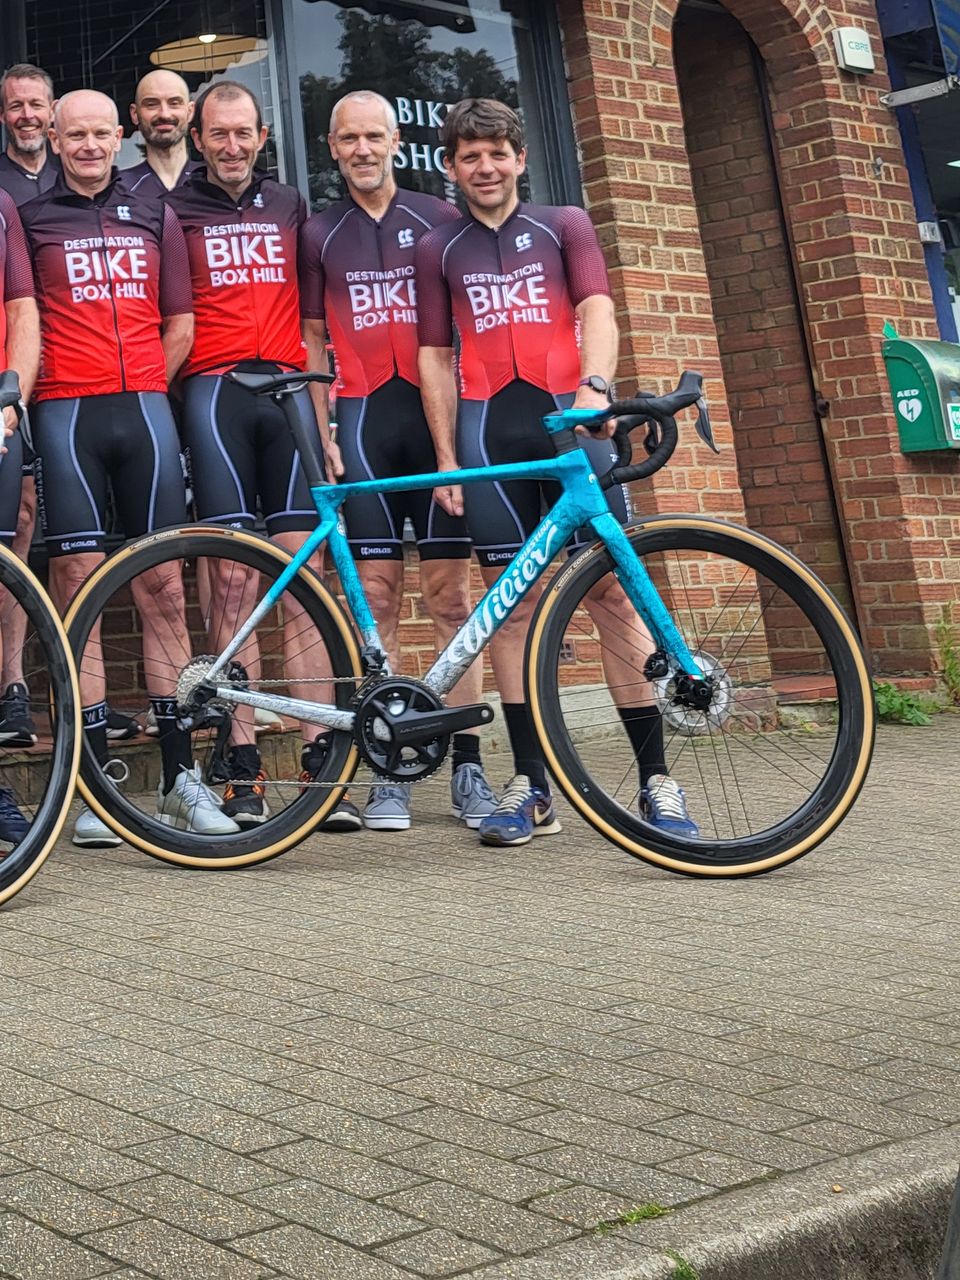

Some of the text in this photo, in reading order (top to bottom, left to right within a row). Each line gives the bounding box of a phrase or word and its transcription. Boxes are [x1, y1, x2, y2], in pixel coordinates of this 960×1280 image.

[395, 96, 455, 129] BIK
[393, 141, 448, 175] SHO
[203, 222, 280, 237] DESTINATION
[63, 236, 145, 251] DESTINATION
[204, 234, 287, 270] BIKE
[65, 248, 149, 285] BIKE
[210, 266, 288, 288] BOX HILL
[345, 265, 416, 282] DESTINATIO
[462, 261, 545, 285] DESTINATION
[71, 282, 148, 304] BOX HILL
[465, 275, 550, 317] BIKE
[353, 310, 390, 331] BOX
[474, 307, 553, 334] BOX HILL
[897, 388, 919, 398] AED
[447, 524, 558, 664] Wilier
